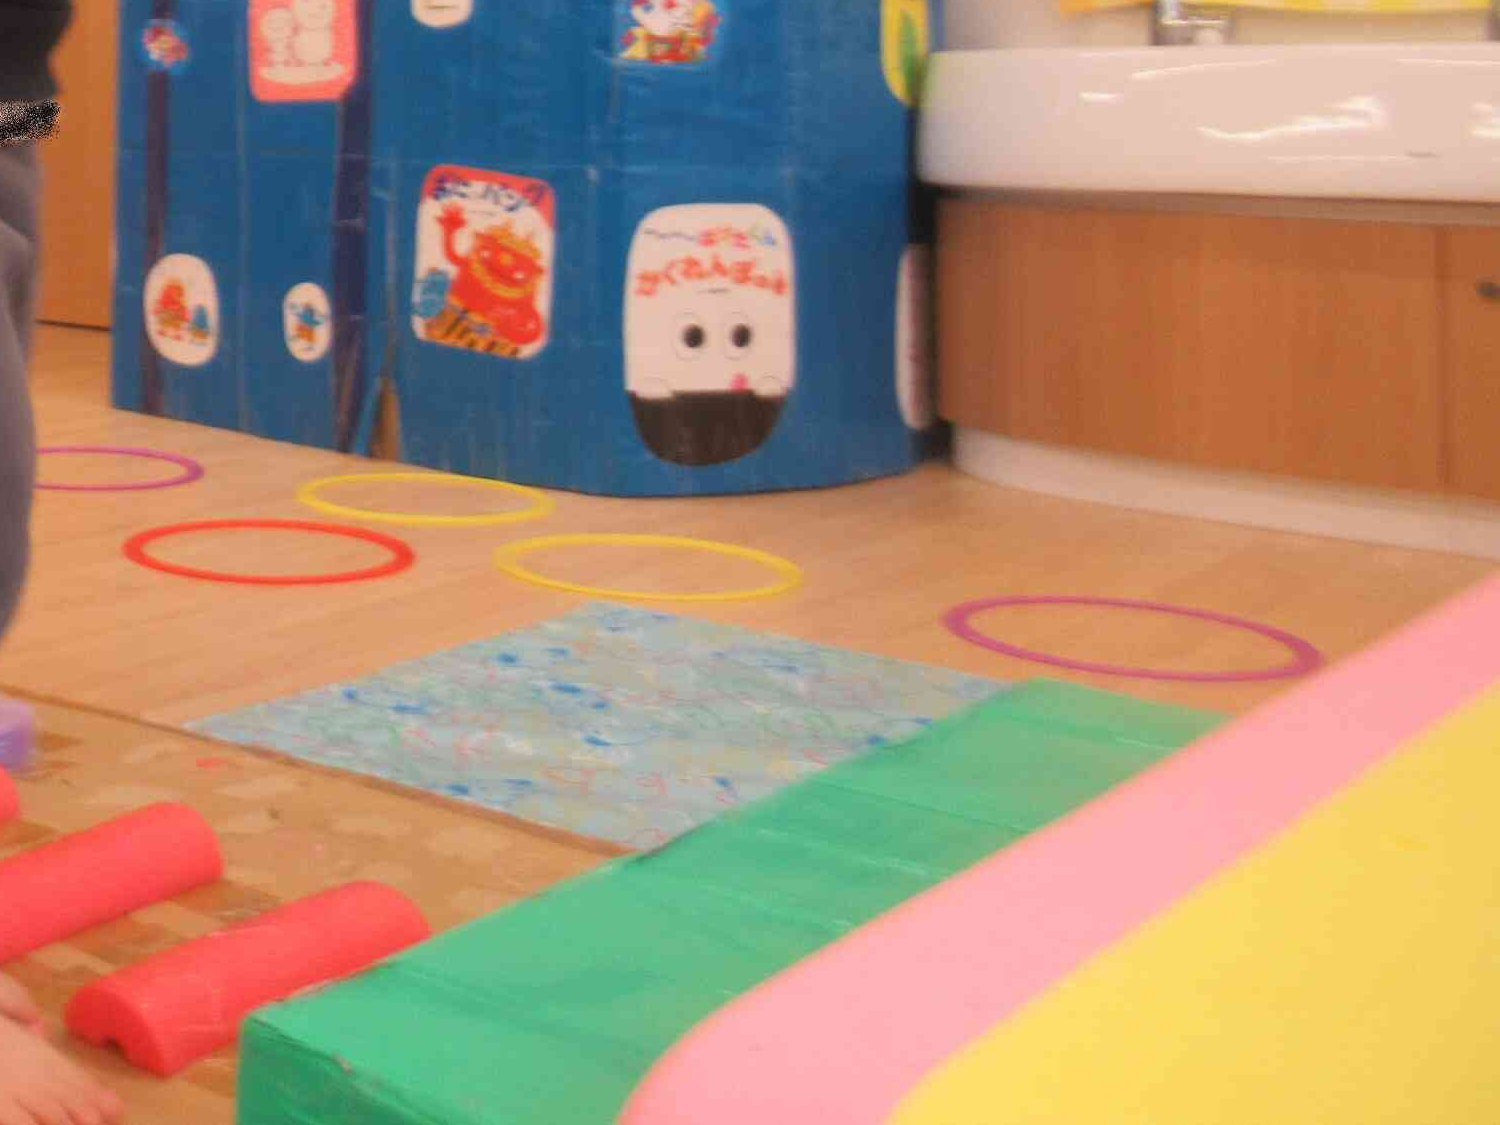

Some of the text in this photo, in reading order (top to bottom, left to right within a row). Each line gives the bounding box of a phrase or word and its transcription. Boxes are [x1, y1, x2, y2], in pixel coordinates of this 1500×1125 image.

[432, 173, 549, 213] おにパンツ
